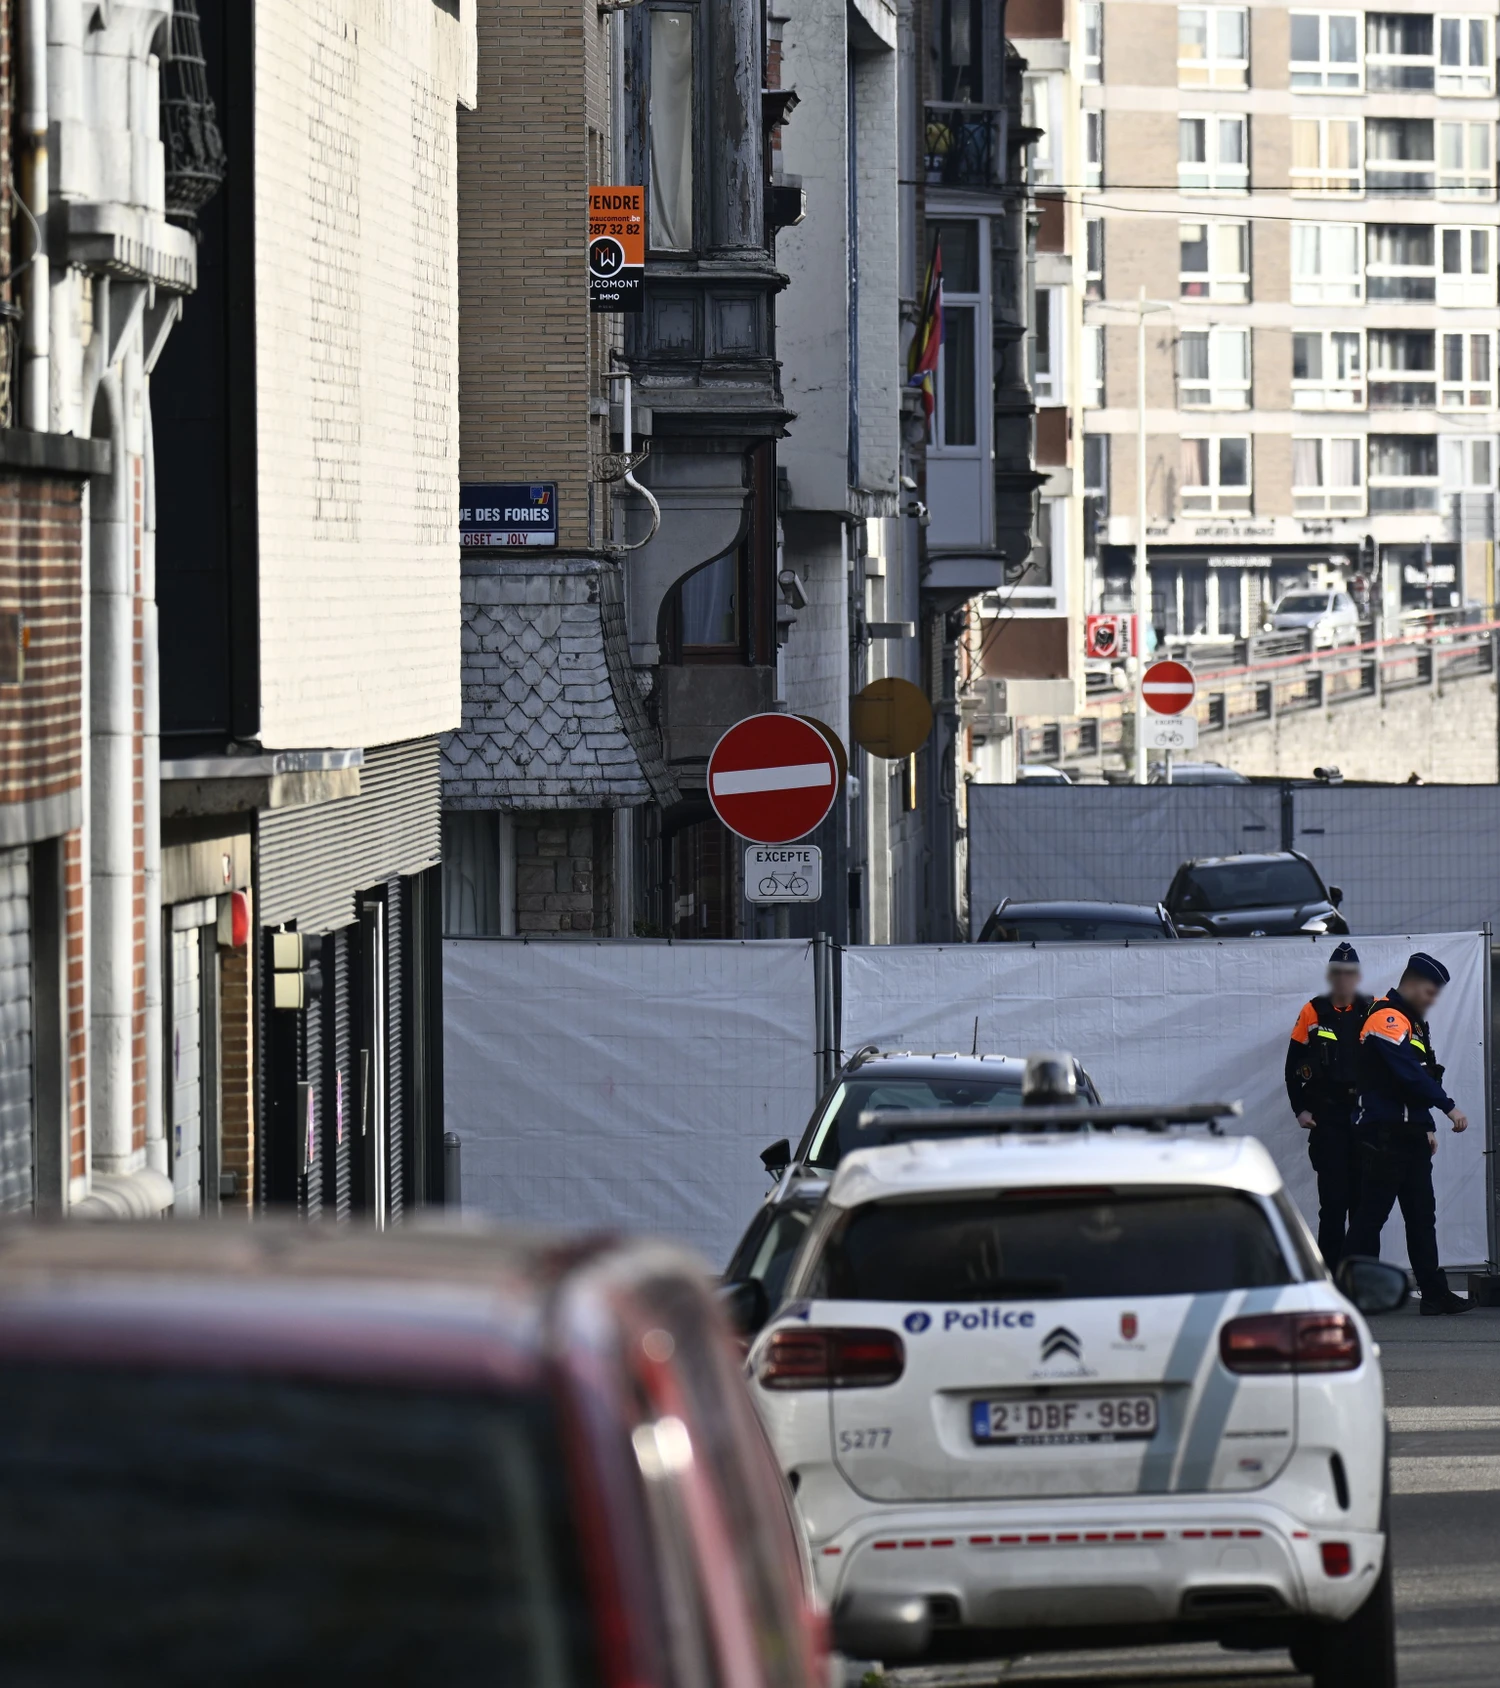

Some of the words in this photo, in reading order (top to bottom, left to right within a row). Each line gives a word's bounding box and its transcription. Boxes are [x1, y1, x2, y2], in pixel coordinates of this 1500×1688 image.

[609, 224, 623, 235] 32
[626, 224, 640, 235] 82
[599, 293, 620, 301] IMMO
[475, 508, 501, 521] DES
[504, 507, 550, 522] FORIES
[463, 533, 492, 545] CISET
[506, 533, 529, 545] JOLY
[756, 851, 811, 863] EXCEPTE
[943, 1307, 1035, 1332] Police
